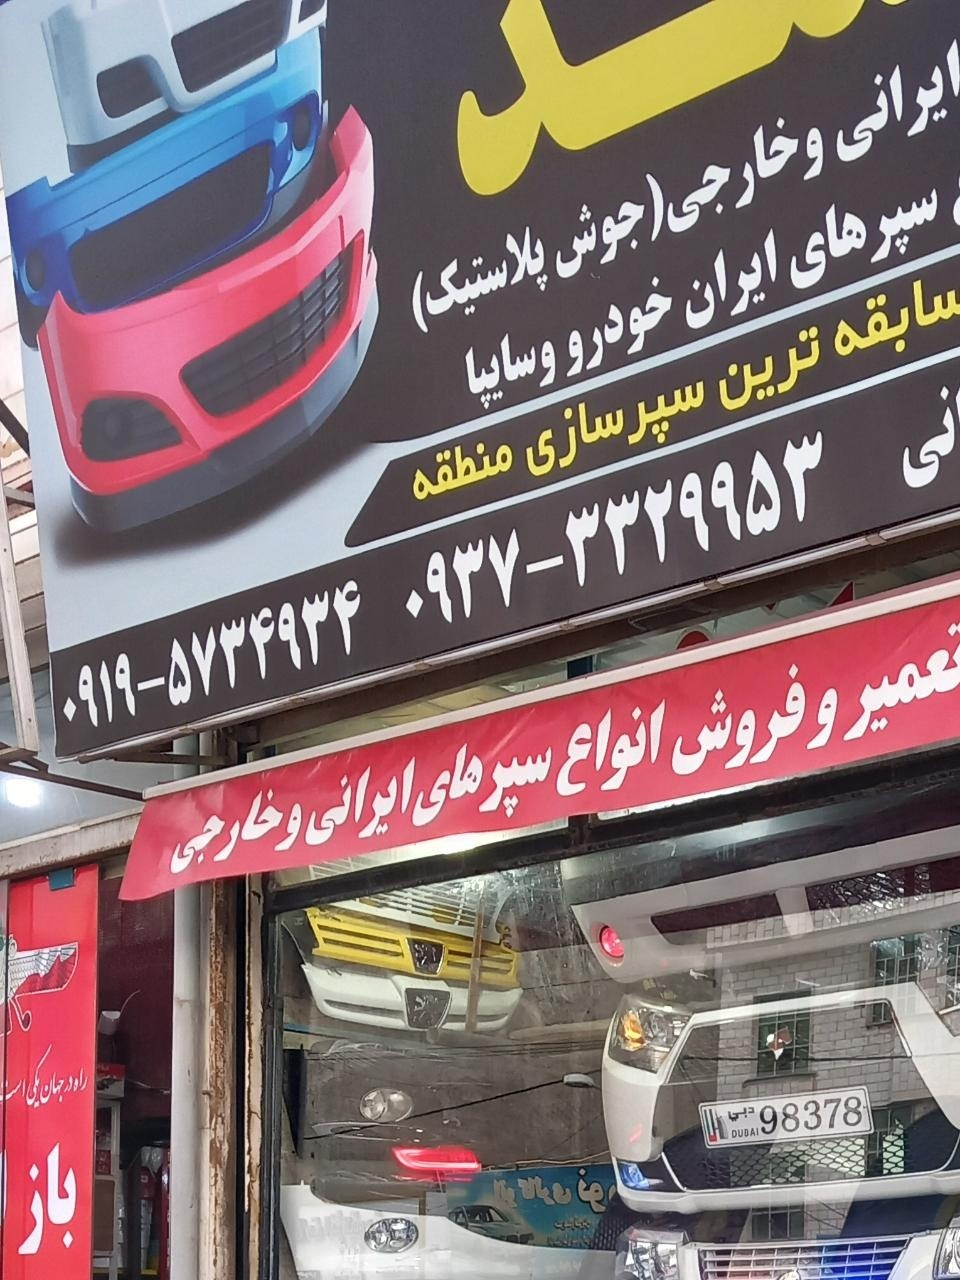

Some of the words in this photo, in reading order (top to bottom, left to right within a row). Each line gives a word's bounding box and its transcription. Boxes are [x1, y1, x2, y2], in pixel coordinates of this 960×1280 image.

[685, 229, 777, 329] ایران
[566, 277, 672, 377] خودرو
[719, 327, 820, 411] ترین
[412, 446, 513, 500] منطقه
[556, 702, 665, 797] انواع
[305, 757, 415, 847] ایرانی
[731, 1127, 759, 1138] DUBAI
[759, 1095, 863, 1135] 98378
[17, 1142, 77, 1255] باز
